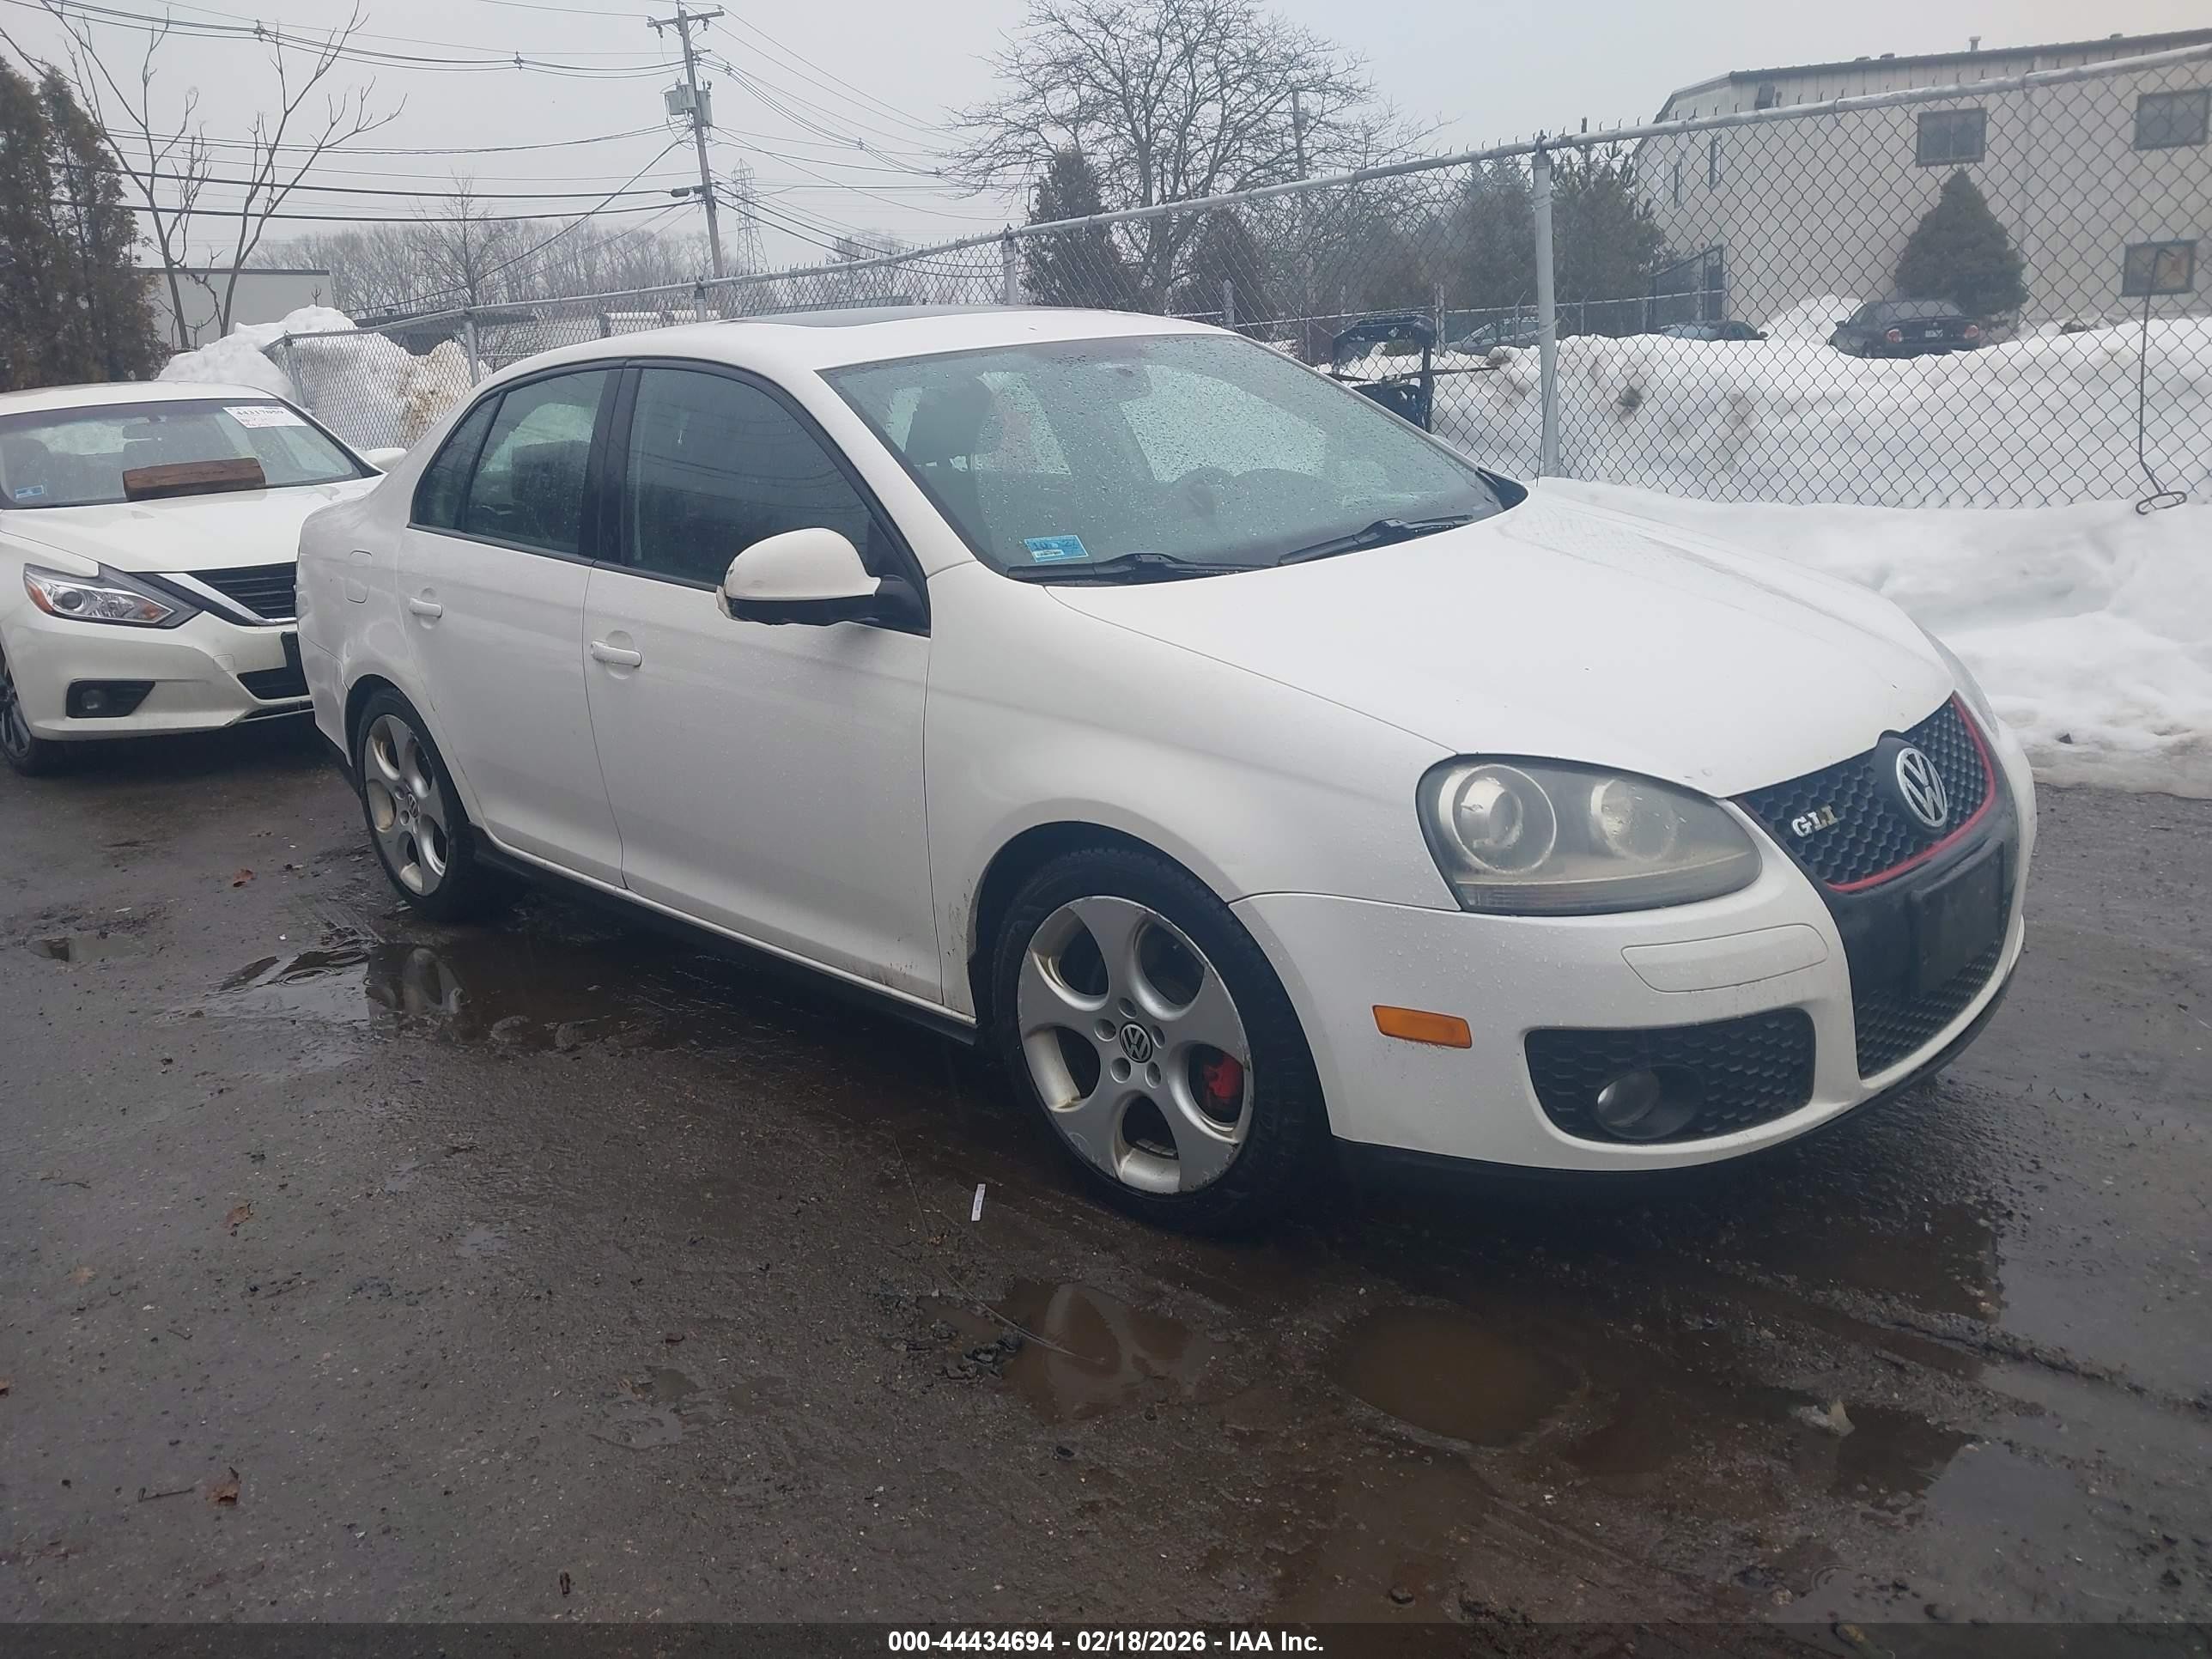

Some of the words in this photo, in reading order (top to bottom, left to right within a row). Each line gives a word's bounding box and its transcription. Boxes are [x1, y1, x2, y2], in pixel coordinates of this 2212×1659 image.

[1897, 749, 1947, 826] VW
[1792, 805, 1838, 838] GLI
[1121, 1025, 1151, 1060] VW
